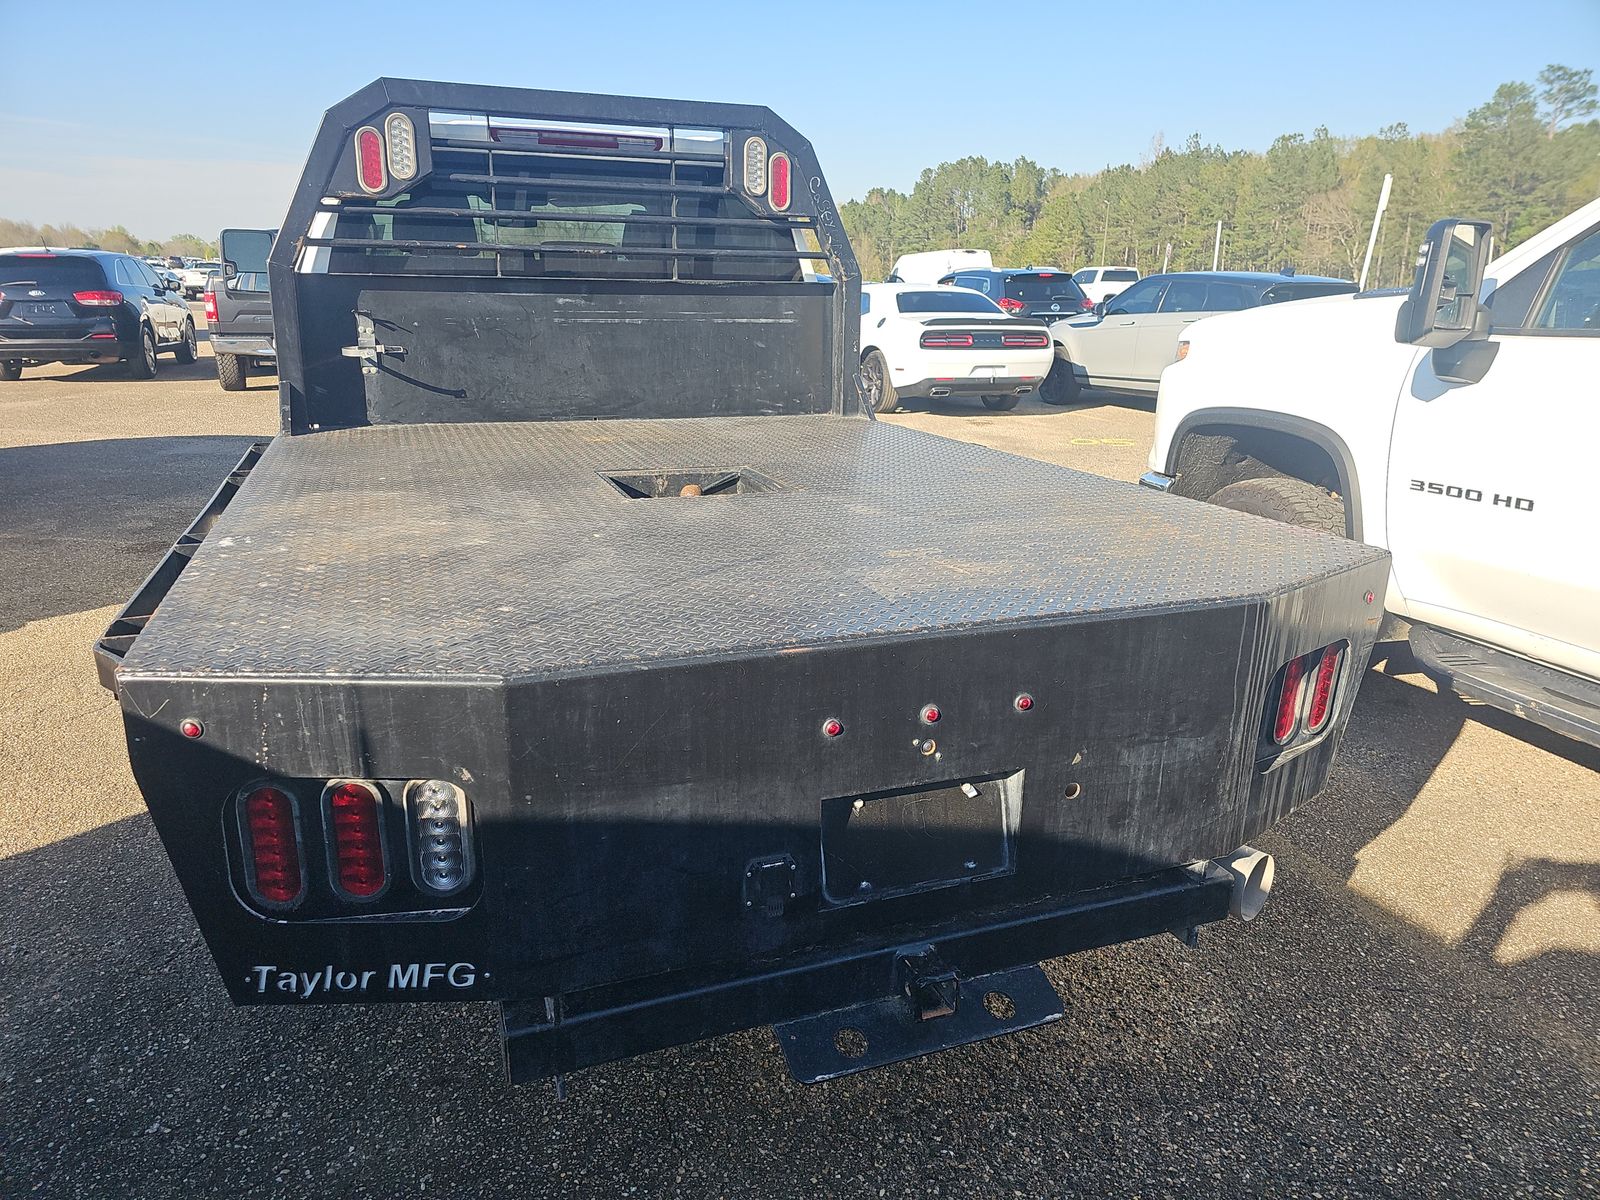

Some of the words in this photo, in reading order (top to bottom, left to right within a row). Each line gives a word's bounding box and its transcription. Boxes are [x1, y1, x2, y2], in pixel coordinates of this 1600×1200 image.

[1409, 479, 1483, 502] 3500
[1493, 493, 1534, 512] HD
[252, 965, 376, 999] Taylor
[387, 962, 476, 989] MFG
